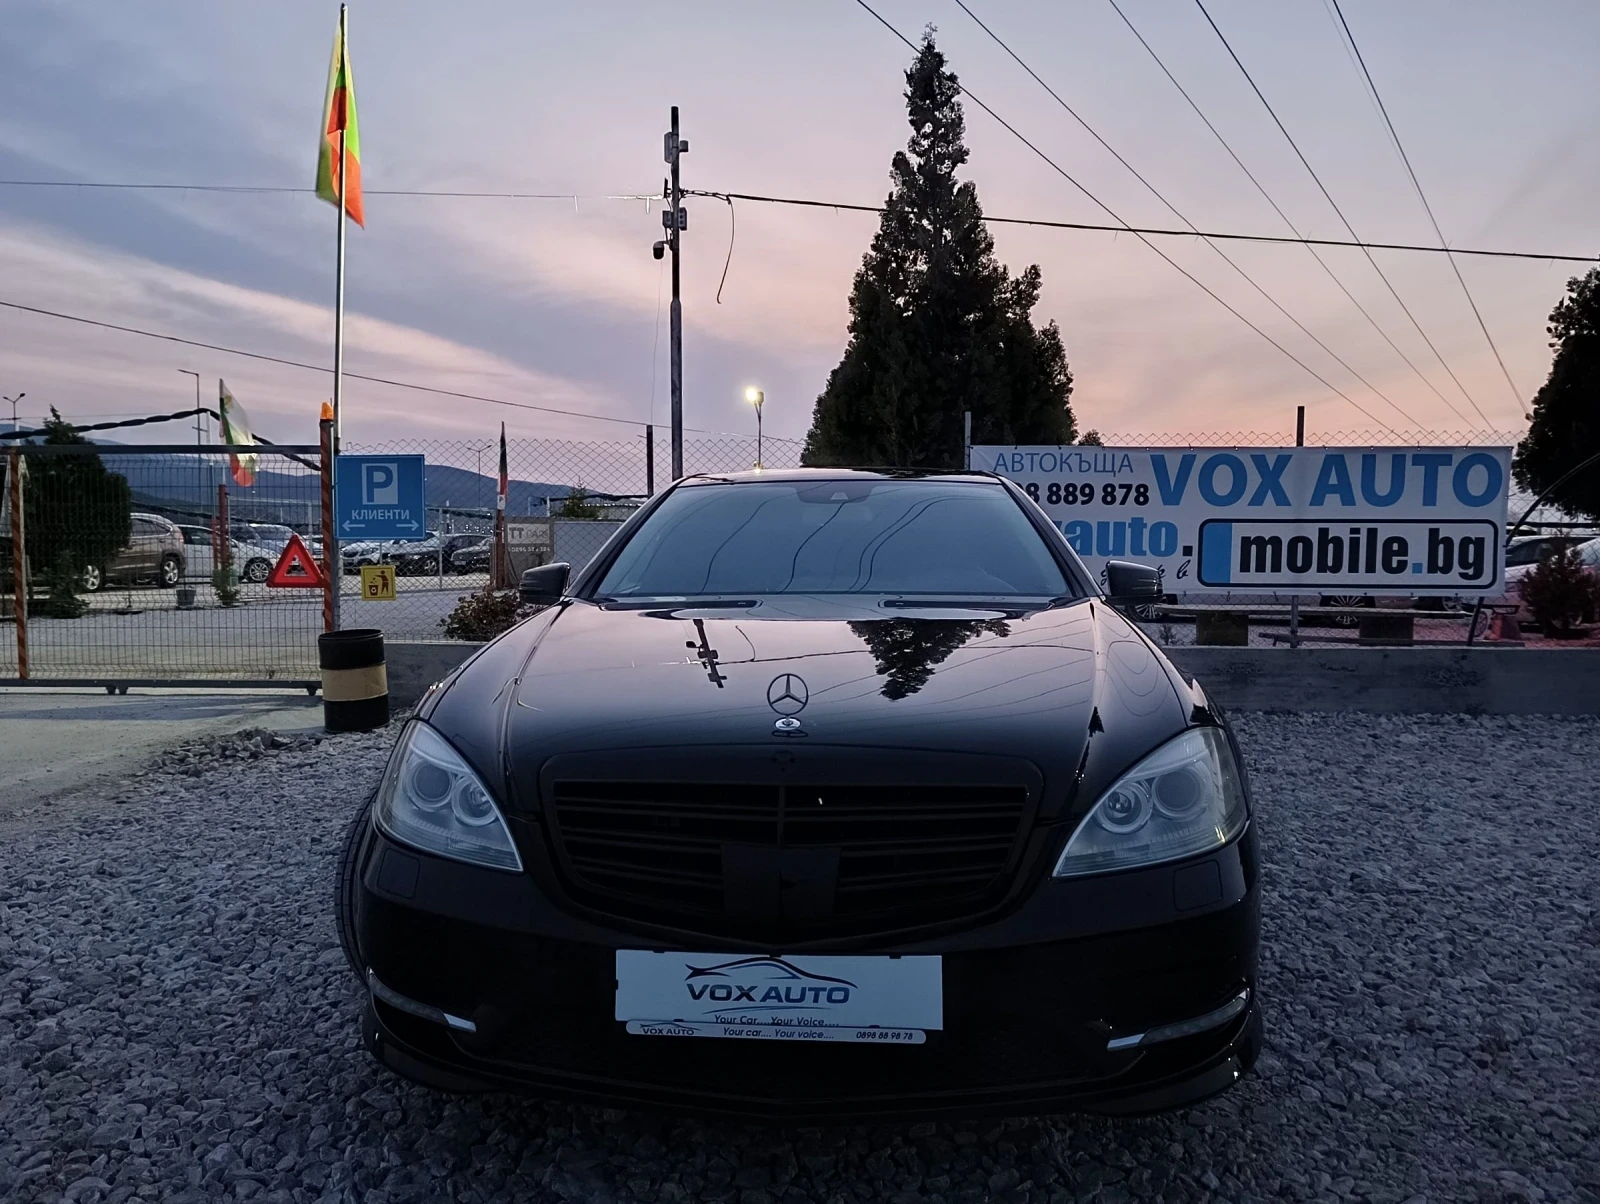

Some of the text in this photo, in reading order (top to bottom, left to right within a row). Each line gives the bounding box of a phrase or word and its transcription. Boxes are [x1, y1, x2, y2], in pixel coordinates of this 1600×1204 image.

[993, 452, 1134, 477] АВТОКЪЩА
[366, 465, 393, 503] P
[1150, 453, 1503, 507] VOX AUTO
[1046, 482, 1095, 505] 889
[1101, 483, 1150, 506] 878
[351, 509, 410, 520] КЛИЕНТИ
[509, 527, 525, 539] TT
[1054, 516, 1486, 581] auto. mobile.bg
[686, 983, 850, 1004] VOX AUTO
[715, 1015, 737, 1024] Your
[666, 1028, 694, 1036] AUTO
[723, 1027, 745, 1036] Your
[774, 1029, 797, 1038] Your
[856, 1031, 913, 1040] 0898 88 98 78
